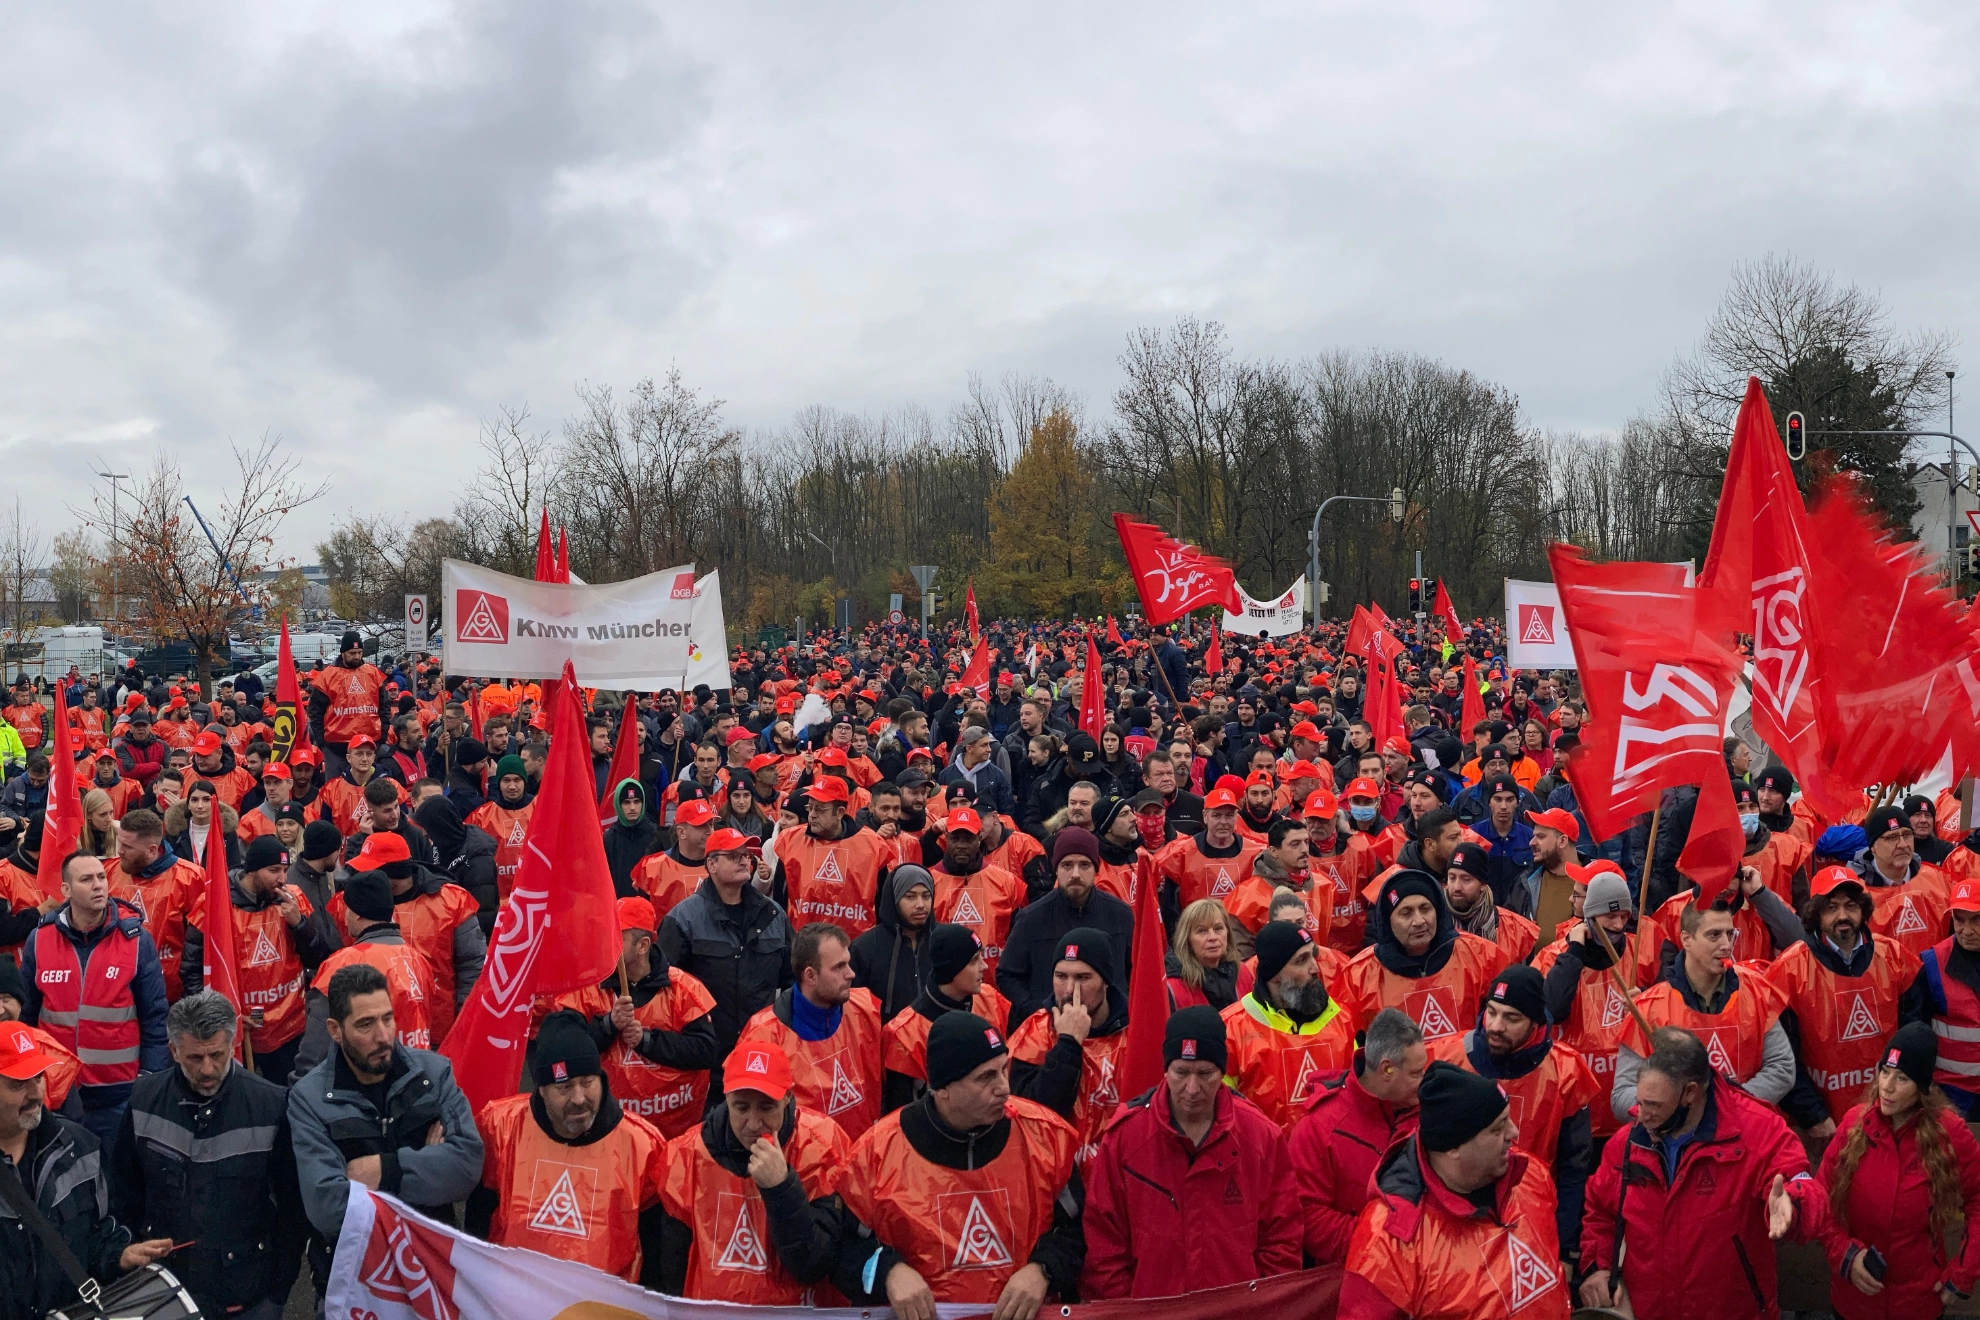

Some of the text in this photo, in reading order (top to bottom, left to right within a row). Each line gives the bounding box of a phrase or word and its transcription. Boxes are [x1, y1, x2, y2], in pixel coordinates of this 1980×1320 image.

[673, 588, 691, 598] DGB
[517, 618, 578, 639] KMW
[1083, 751, 1094, 762] P
[41, 966, 120, 983] GEBT 8!
